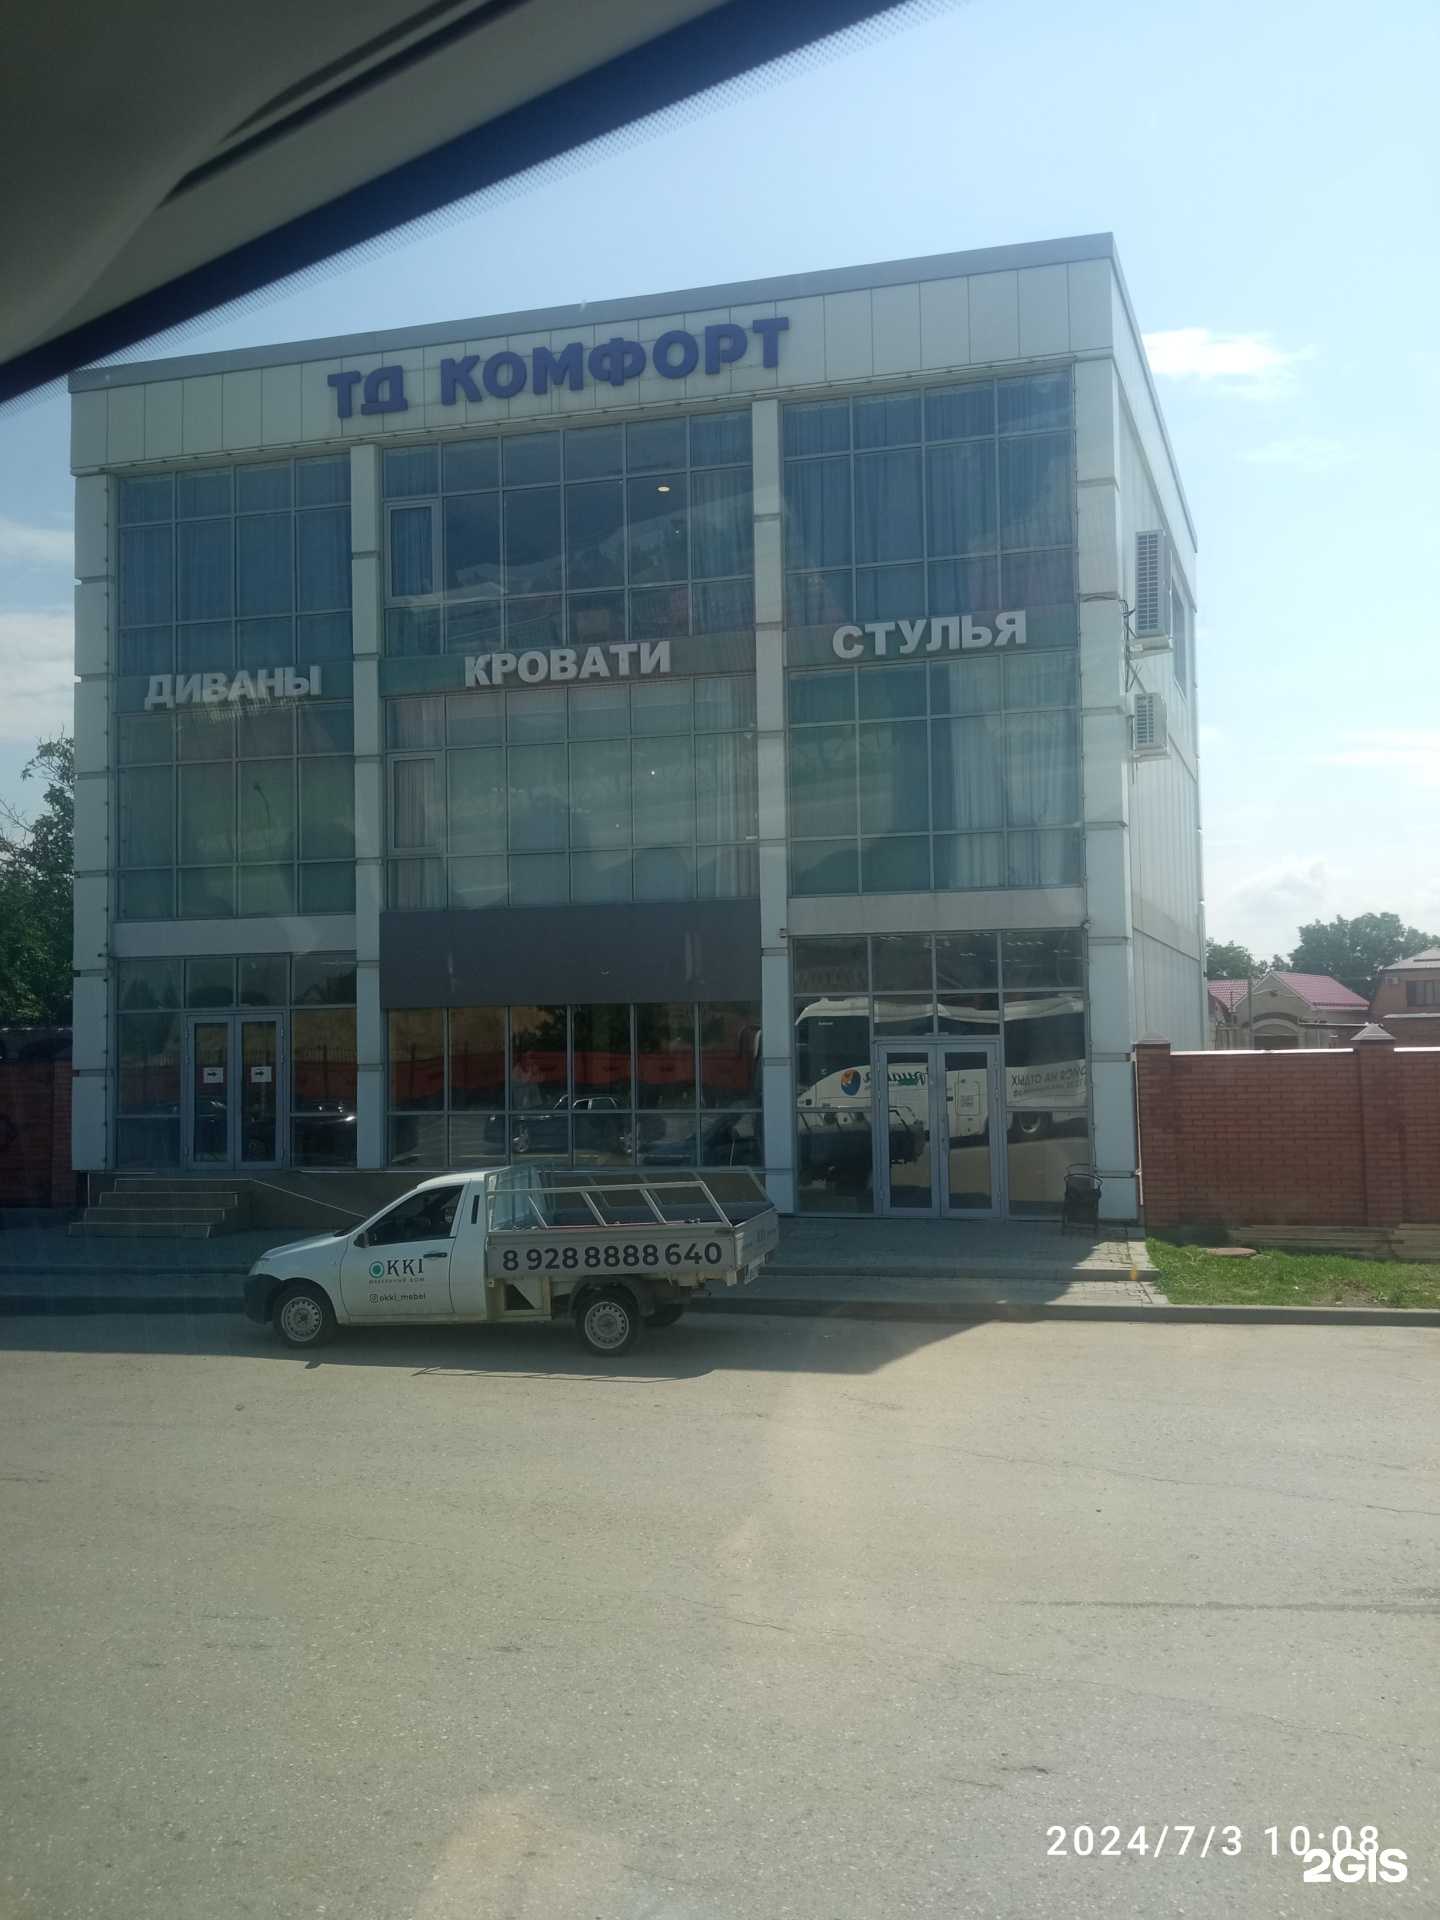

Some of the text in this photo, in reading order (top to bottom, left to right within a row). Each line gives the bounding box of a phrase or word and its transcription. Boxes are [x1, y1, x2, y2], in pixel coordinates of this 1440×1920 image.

[327, 316, 790, 419] ТД КОМФОРТ
[832, 610, 1027, 660] СТУЛЬЯ
[144, 664, 322, 711] ДИВАНЫ
[464, 640, 672, 688] КРОВАТИ
